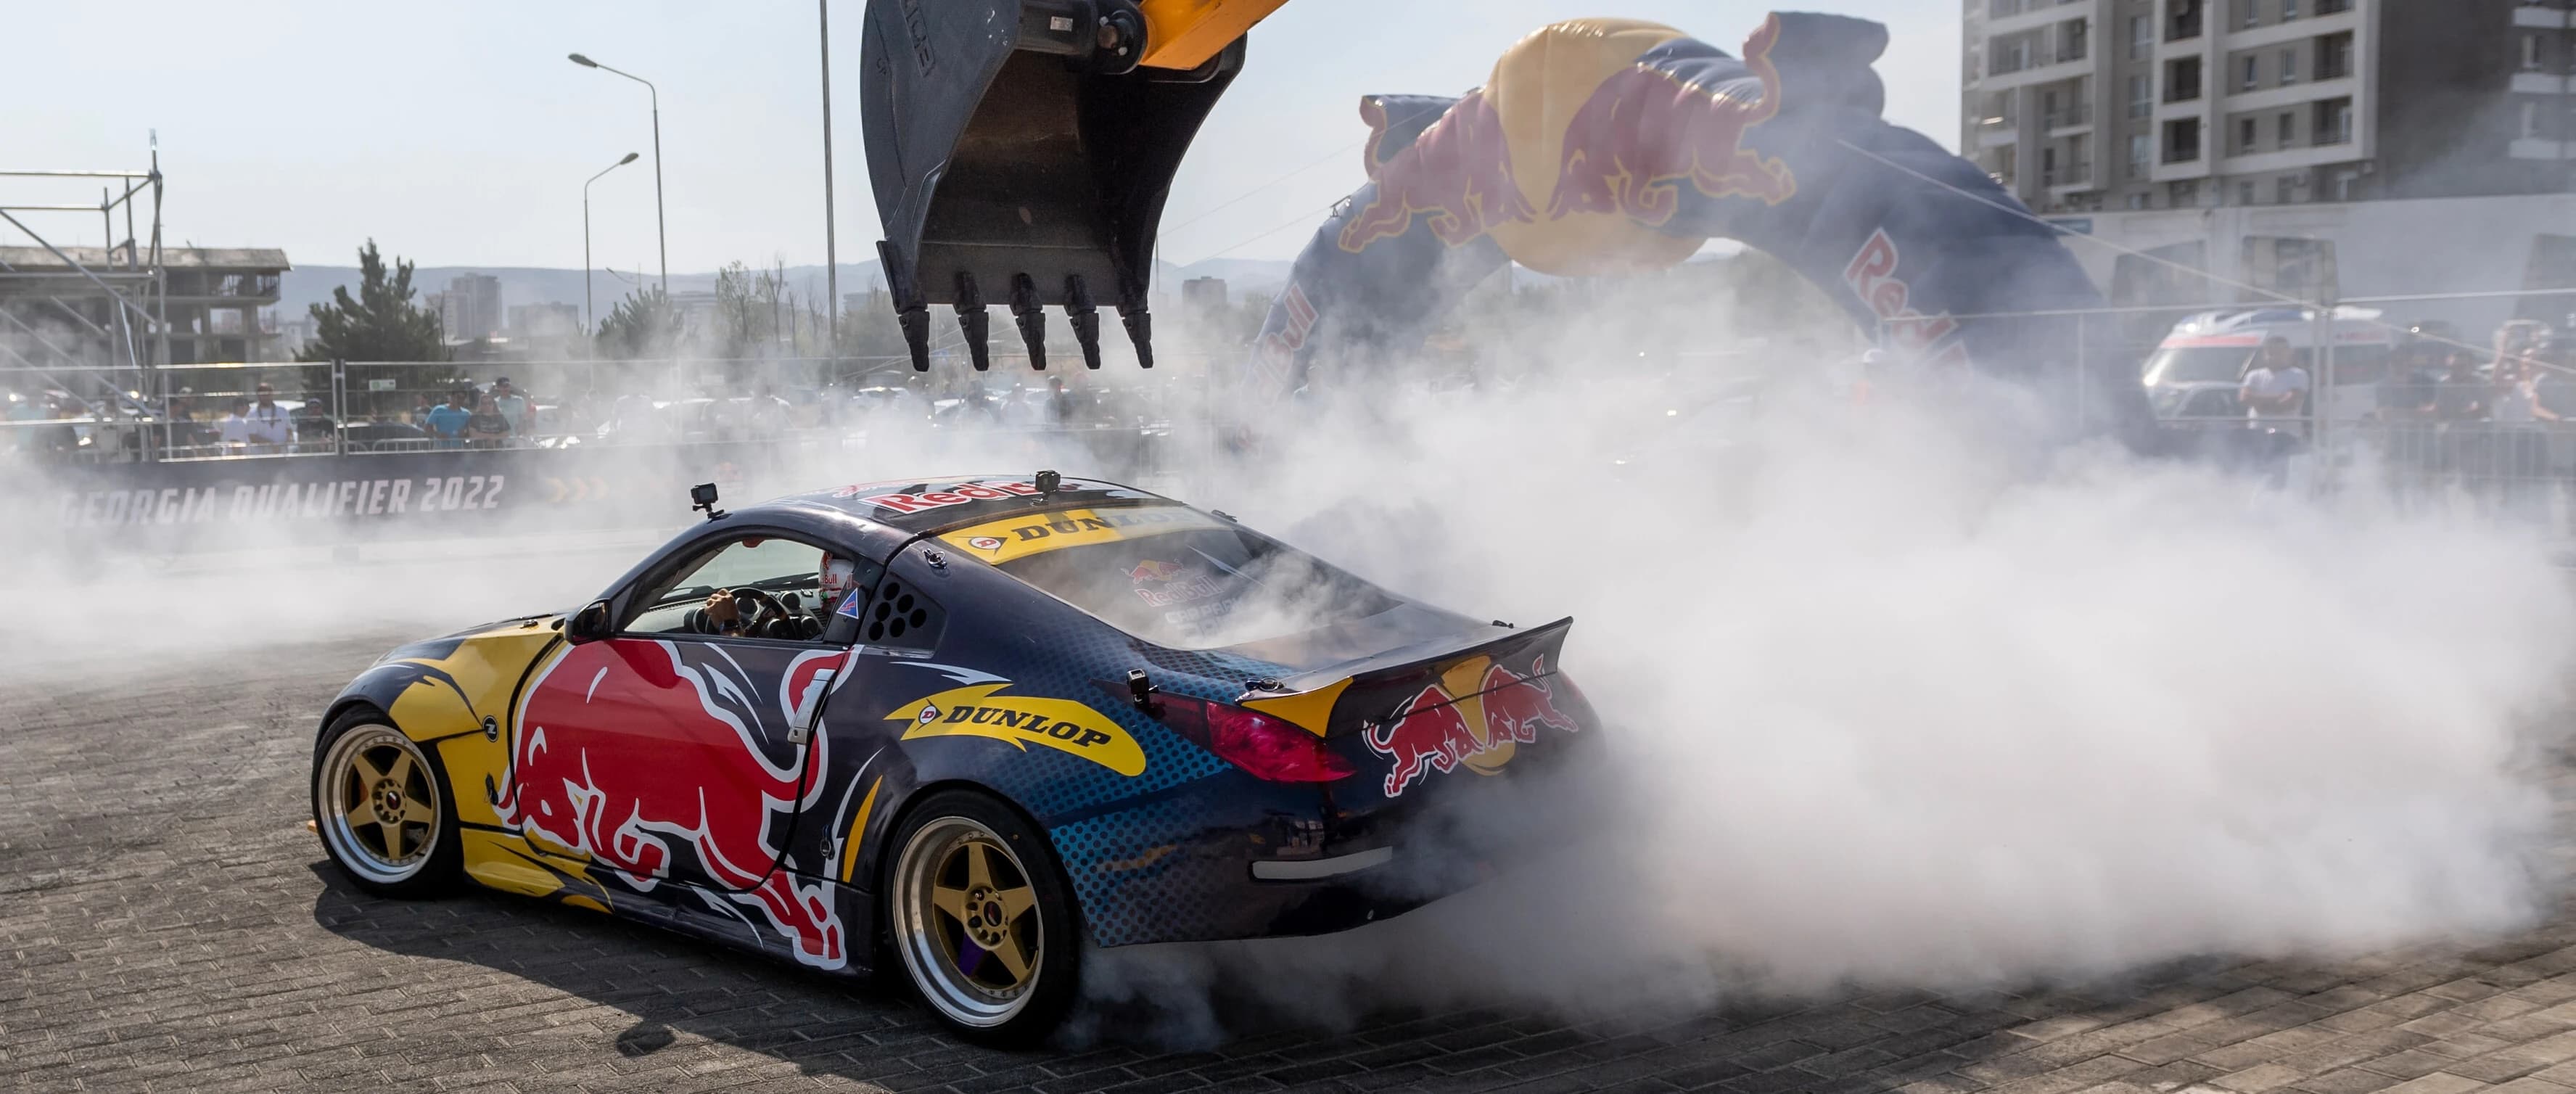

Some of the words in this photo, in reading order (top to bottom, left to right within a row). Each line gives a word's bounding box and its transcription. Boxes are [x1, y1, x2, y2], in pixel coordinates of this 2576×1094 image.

[61, 487, 215, 528] GEORGIA
[229, 479, 412, 519] QUALIFIER
[420, 475, 505, 511] 2022
[942, 706, 1112, 747] DUNLOP
